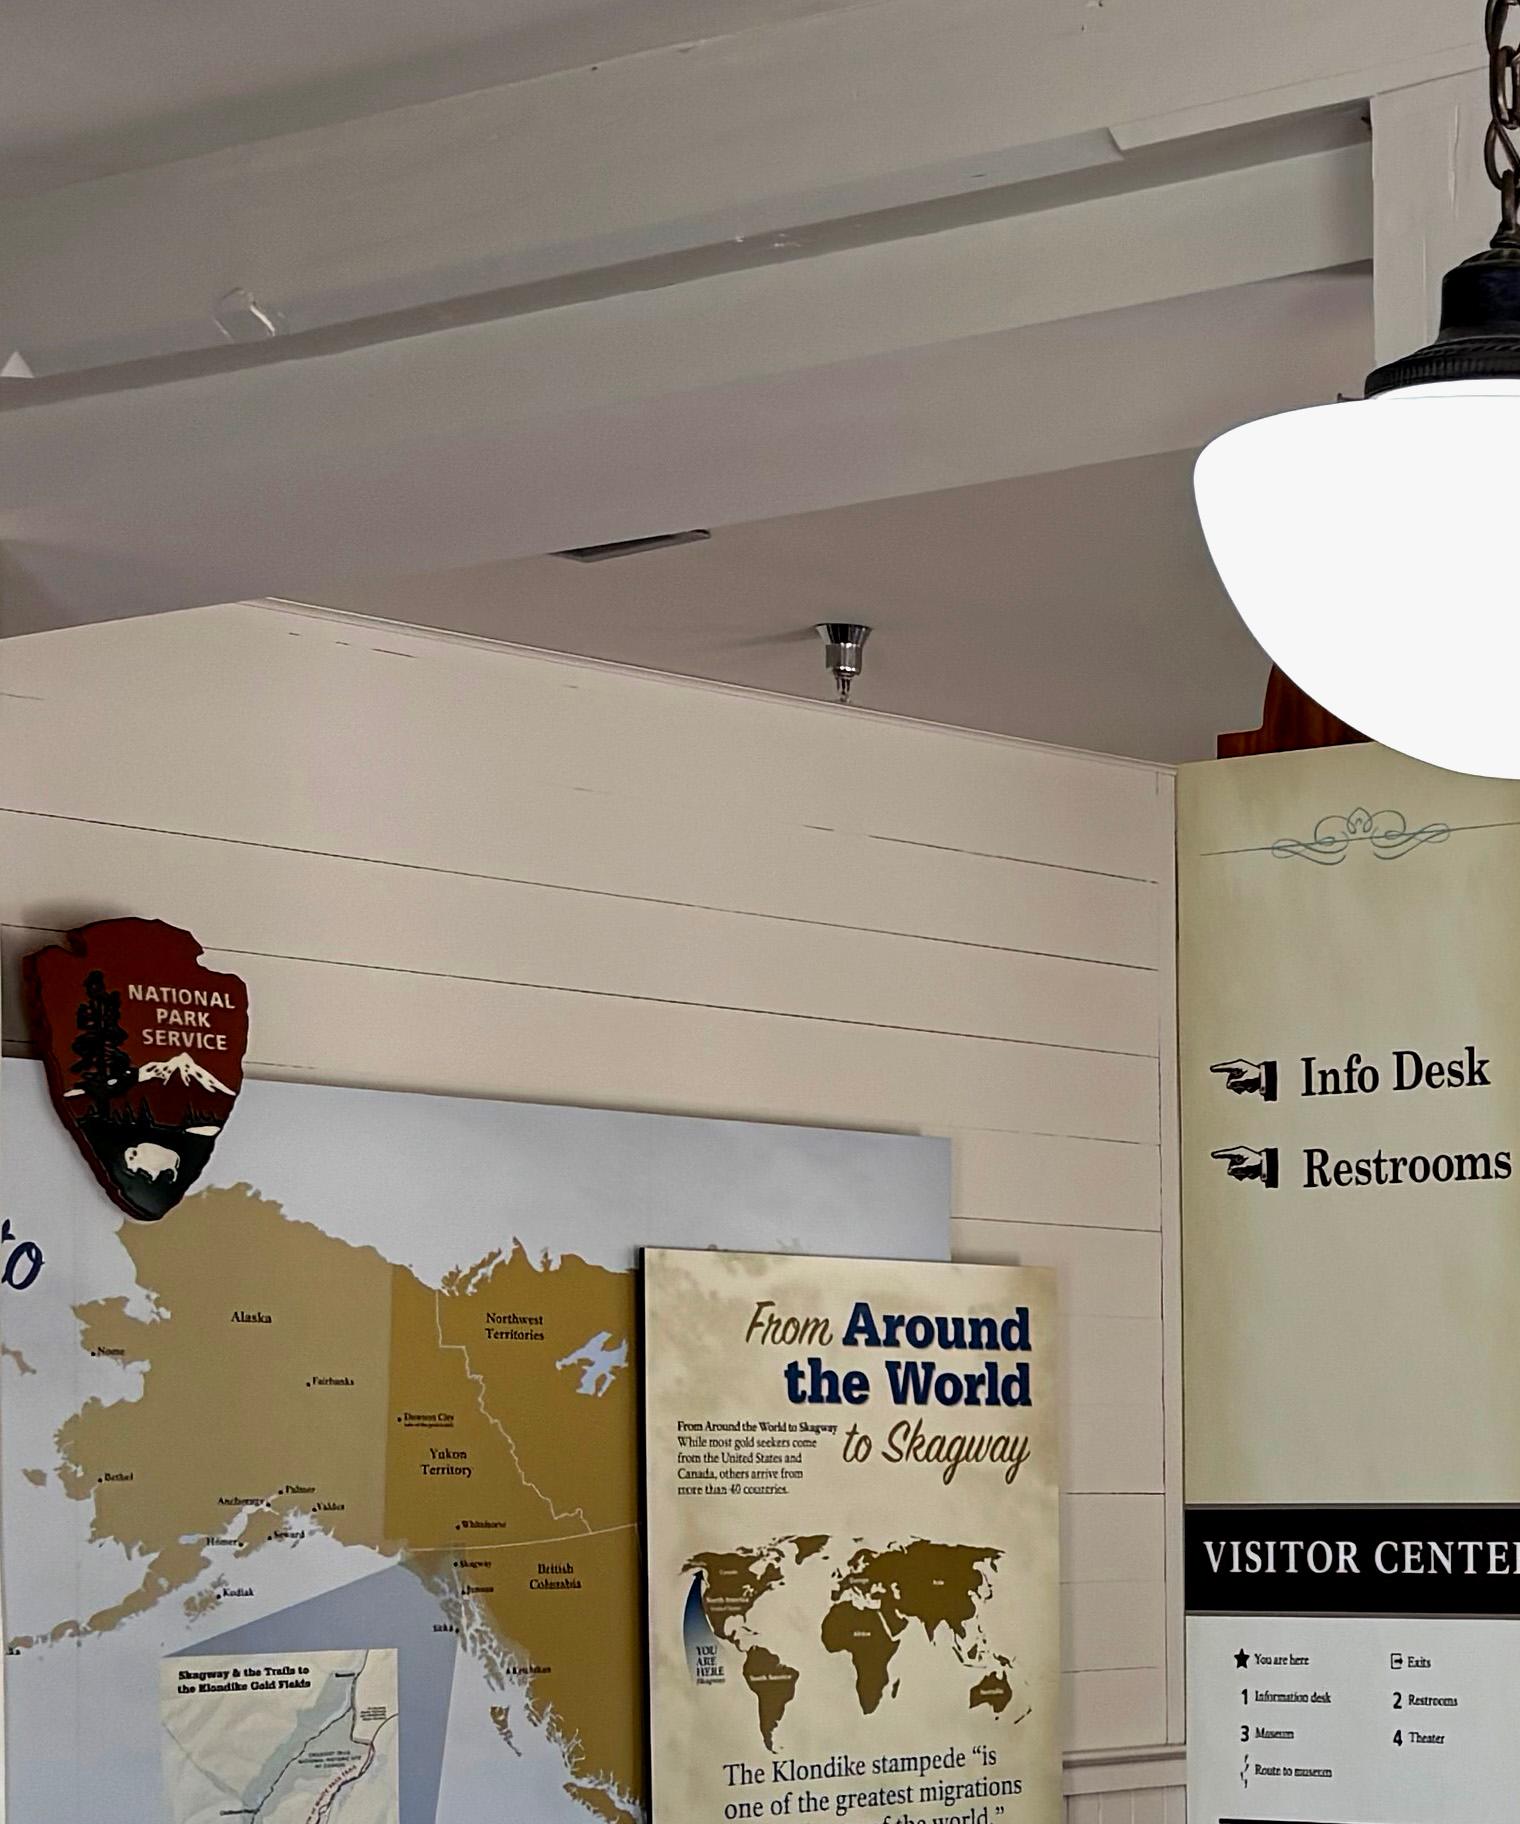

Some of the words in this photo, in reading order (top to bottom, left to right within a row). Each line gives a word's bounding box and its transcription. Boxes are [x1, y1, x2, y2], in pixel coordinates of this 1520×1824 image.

[128, 984, 236, 1009] NATIONAL
[156, 1008, 211, 1028] PARK
[142, 1028, 228, 1050] SERVICE
[1301, 1053, 1380, 1097] Info
[1392, 1046, 1492, 1091] Desk
[1302, 1148, 1513, 1188] Restrooms
[231, 1310, 272, 1324] Alaska
[486, 1312, 544, 1326] Northwest
[745, 1300, 833, 1346] From
[842, 1302, 1032, 1352] Around
[485, 1328, 545, 1341] Territories
[312, 1376, 355, 1386] Fairbanks
[784, 1357, 870, 1405] the
[885, 1360, 1032, 1407] World
[677, 1421, 703, 1432] From
[705, 1421, 741, 1433] Around
[742, 1421, 757, 1432] the
[759, 1421, 787, 1433] World
[788, 1423, 798, 1433] to
[799, 1421, 838, 1436] Skagway
[678, 1436, 708, 1448] While
[709, 1437, 732, 1448] most
[733, 1436, 755, 1450] gold
[756, 1436, 791, 1449] seekers
[792, 1438, 817, 1449] come
[430, 1448, 467, 1460] Yukon
[677, 1452, 701, 1464] from
[703, 1452, 719, 1464] the
[721, 1452, 754, 1464] United
[756, 1452, 782, 1464] States
[784, 1452, 802, 1464] and
[842, 1422, 872, 1463] to
[881, 1417, 1031, 1485] Skagway
[421, 1464, 473, 1478] Territory
[677, 1467, 717, 1480] Canada,
[719, 1467, 749, 1480] others
[751, 1467, 779, 1480] arrive
[781, 1467, 803, 1480] from
[678, 1485, 703, 1496] more
[705, 1483, 727, 1495] than
[1203, 1540, 1361, 1574] VISITOR
[537, 1563, 574, 1575] British
[529, 1578, 582, 1590] Columbia
[1254, 1654, 1272, 1665] You
[1273, 1656, 1288, 1665] are
[1289, 1654, 1310, 1666] here
[1407, 1656, 1431, 1668] Exits
[178, 1669, 229, 1682] Skagway
[244, 1667, 262, 1677] the
[264, 1666, 297, 1676] Trails
[298, 1666, 310, 1675] to
[178, 1683, 196, 1694] the
[198, 1681, 248, 1694] Klondike
[250, 1680, 276, 1691] Gold
[1241, 1688, 1249, 1705] 1
[1254, 1690, 1309, 1703] Information
[1310, 1691, 1332, 1704] desk
[1392, 1692, 1403, 1709] 2
[1408, 1694, 1458, 1707] Restrooms
[1240, 1725, 1250, 1742] 3
[1254, 1727, 1295, 1740] Museum
[1392, 1729, 1403, 1747] 4
[1408, 1731, 1445, 1745] Theater
[723, 1762, 765, 1786] The
[772, 1754, 866, 1784] Klondike
[872, 1747, 966, 1777] stampede
[971, 1744, 997, 1766] “is
[1254, 1764, 1281, 1776] Route
[1282, 1766, 1293, 1777] to
[1294, 1767, 1333, 1778] museum
[724, 1802, 763, 1820] one
[770, 1792, 793, 1815] of
[798, 1791, 830, 1814] the
[836, 1784, 914, 1816] greatest
[919, 1776, 1023, 1807] migrations
